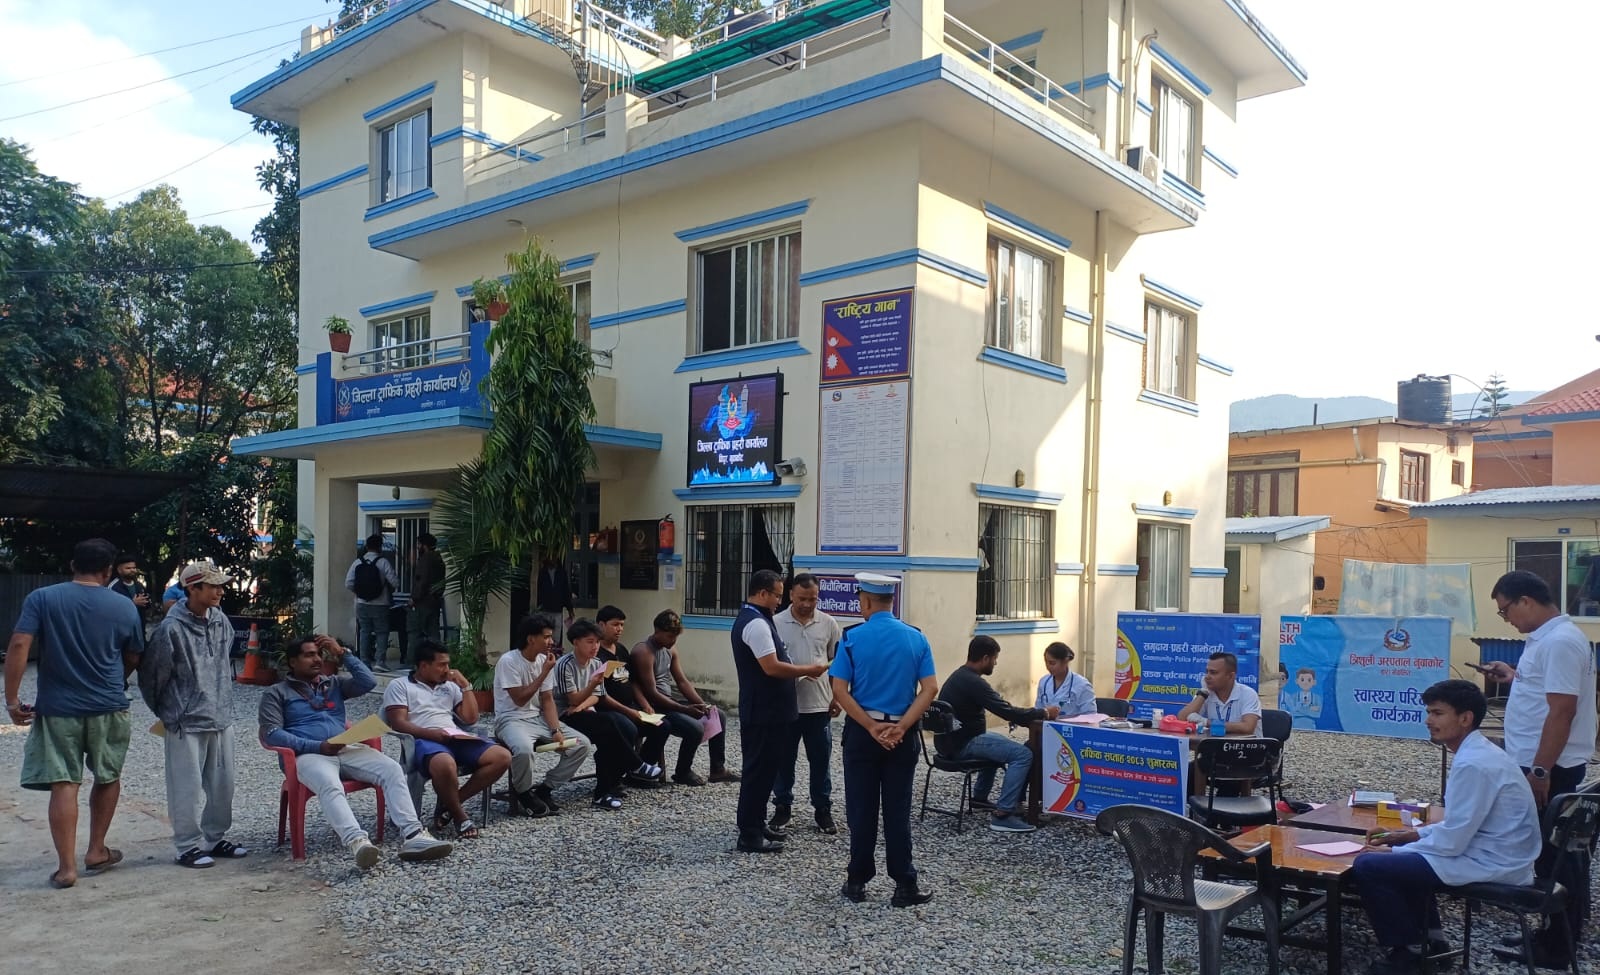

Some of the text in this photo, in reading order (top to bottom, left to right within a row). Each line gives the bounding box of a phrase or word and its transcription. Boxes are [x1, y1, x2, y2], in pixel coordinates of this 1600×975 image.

[352, 387, 376, 403] जिल्ला
[378, 382, 403, 403] ट्राफिक
[404, 378, 422, 398] प्रहरी
[423, 374, 457, 392] कार्यालय
[820, 579, 850, 592] बिचौलिया
[1280, 634, 1294, 643] SK
[1378, 657, 1410, 666] अस्पताल
[1353, 688, 1395, 703] स्वास्थ्य
[1372, 705, 1423, 723] कार्यक्रम
[1080, 746, 1102, 760] ट्राफिक
